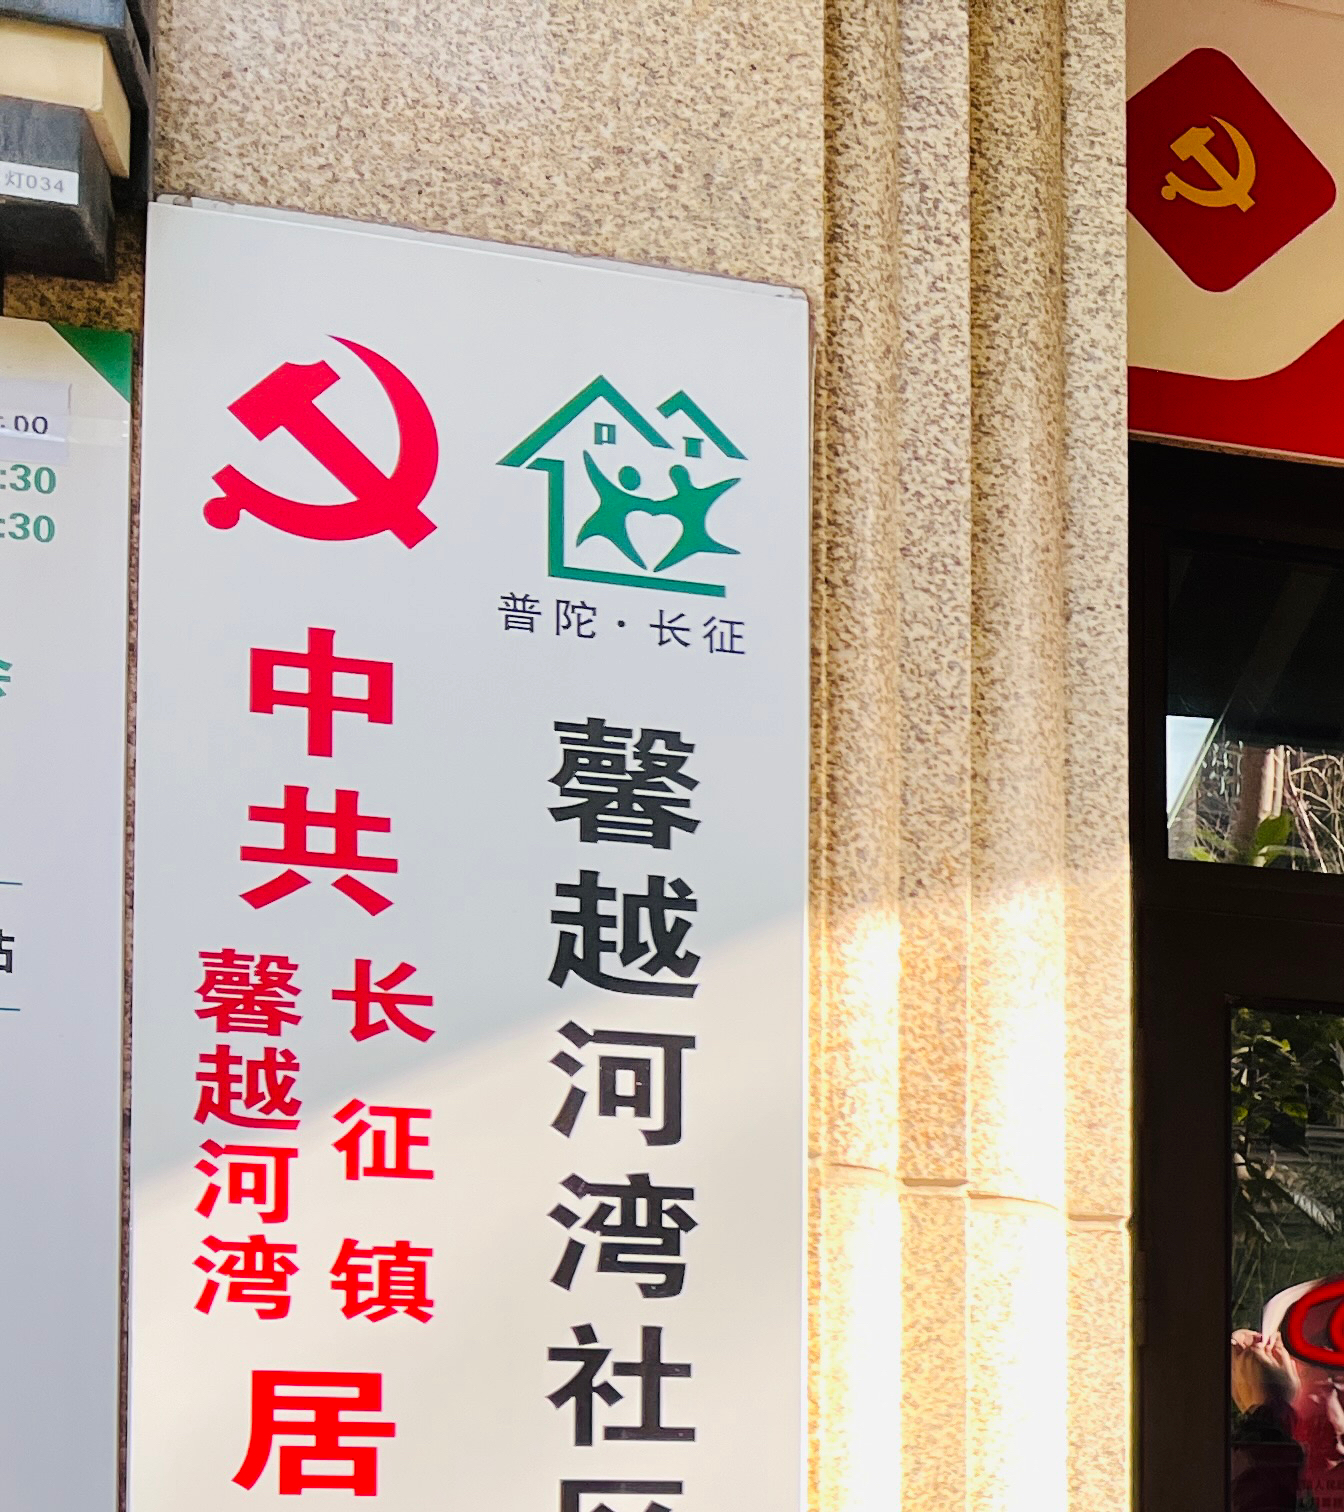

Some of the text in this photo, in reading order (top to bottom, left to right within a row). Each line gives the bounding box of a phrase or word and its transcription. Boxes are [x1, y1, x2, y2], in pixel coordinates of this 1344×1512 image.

[5, 170, 64, 193] 灯034
[240, 627, 399, 917] 中共
[193, 948, 303, 1321] 馨越河湾
[331, 958, 436, 1325] 长征镇
